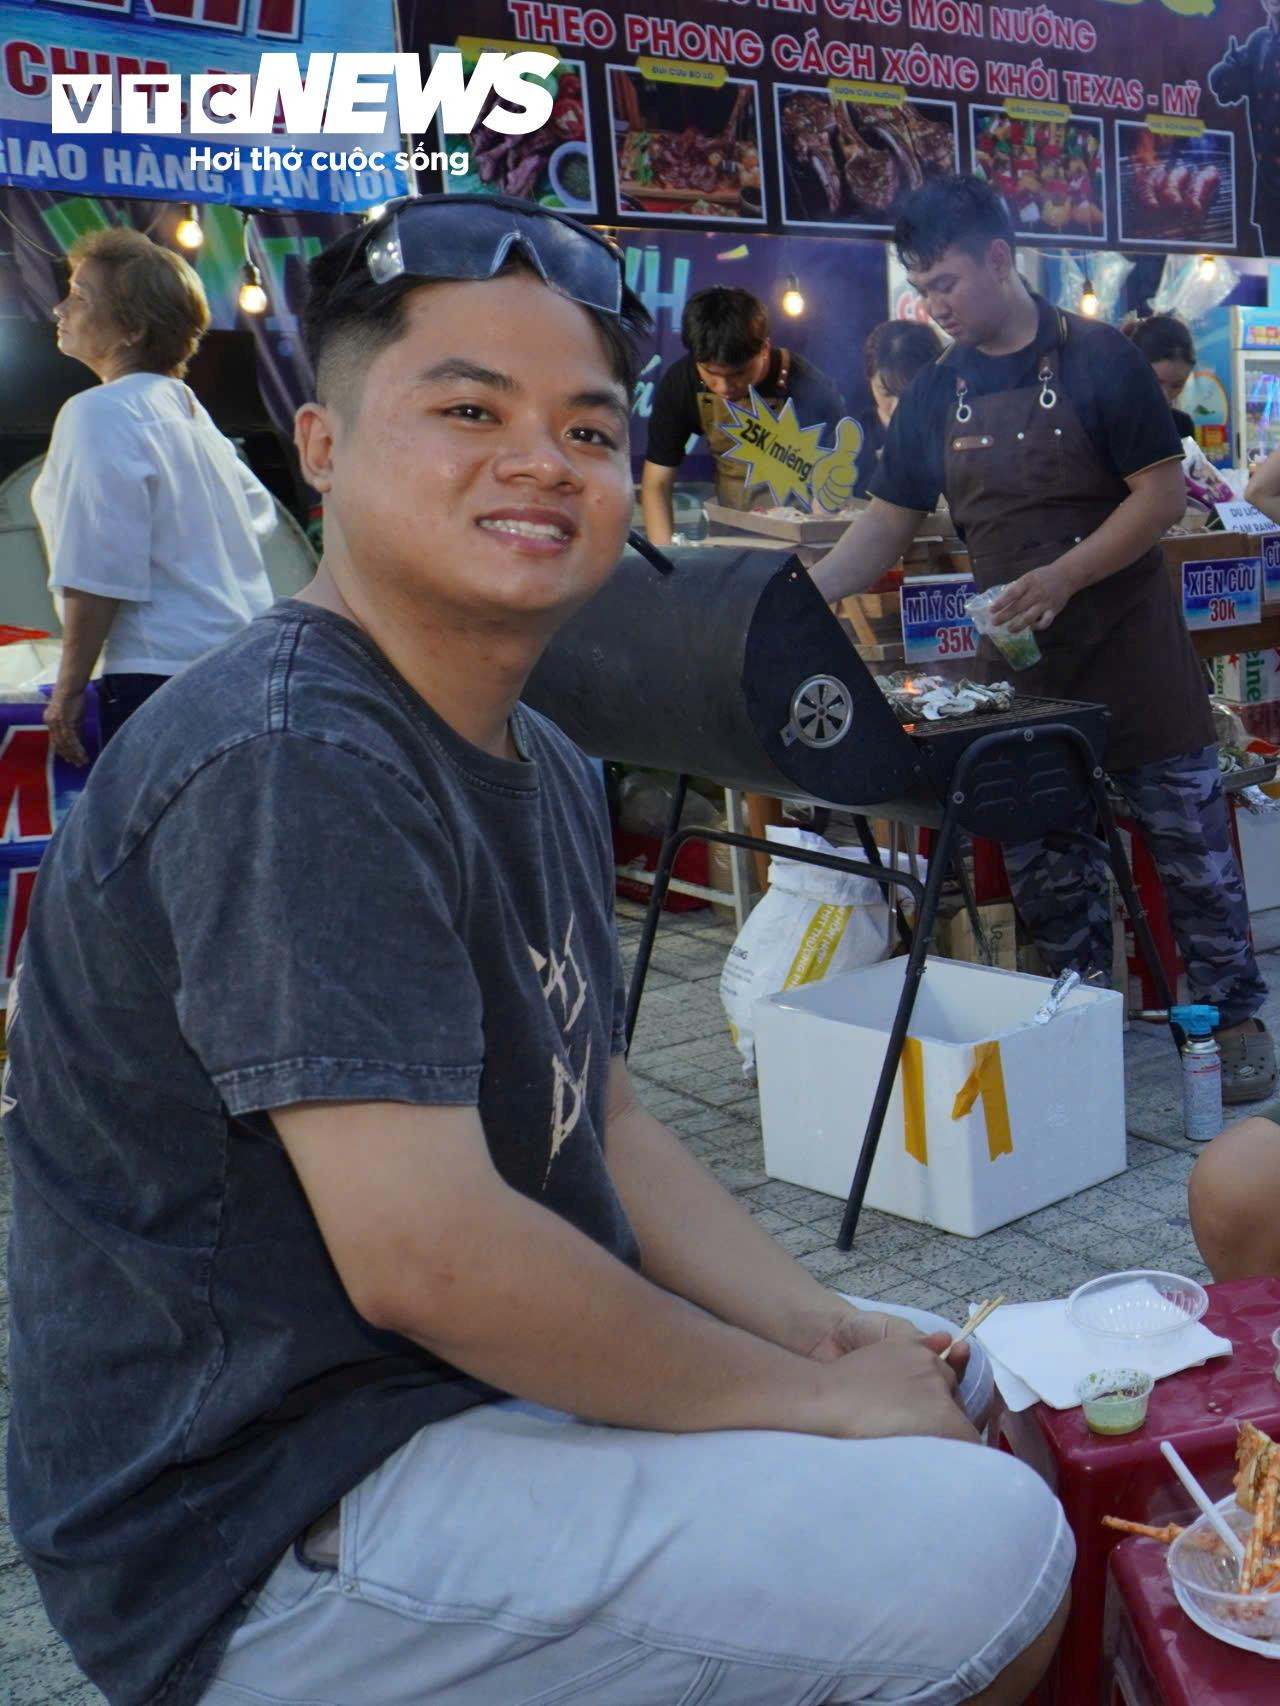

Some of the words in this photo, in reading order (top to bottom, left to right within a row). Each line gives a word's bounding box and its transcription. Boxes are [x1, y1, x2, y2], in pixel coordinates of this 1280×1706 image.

[991, 4, 1097, 52] NƯỚNG
[509, 2, 616, 48] THEO
[625, 15, 764, 68] PHONG
[771, 27, 876, 80] CÁCH
[882, 42, 979, 91] XÔNG
[986, 58, 1058, 100] KHÓI
[1063, 71, 1145, 112] TEXAS
[1161, 81, 1201, 117] MỸ
[0, 136, 87, 181] IAO
[1188, 565, 1225, 597] XIÊN
[1227, 563, 1256, 592] CỪU
[905, 591, 929, 625] MÌ
[930, 590, 943, 622] Ý
[944, 585, 973, 621] SỐ
[936, 625, 976, 655] 35K
